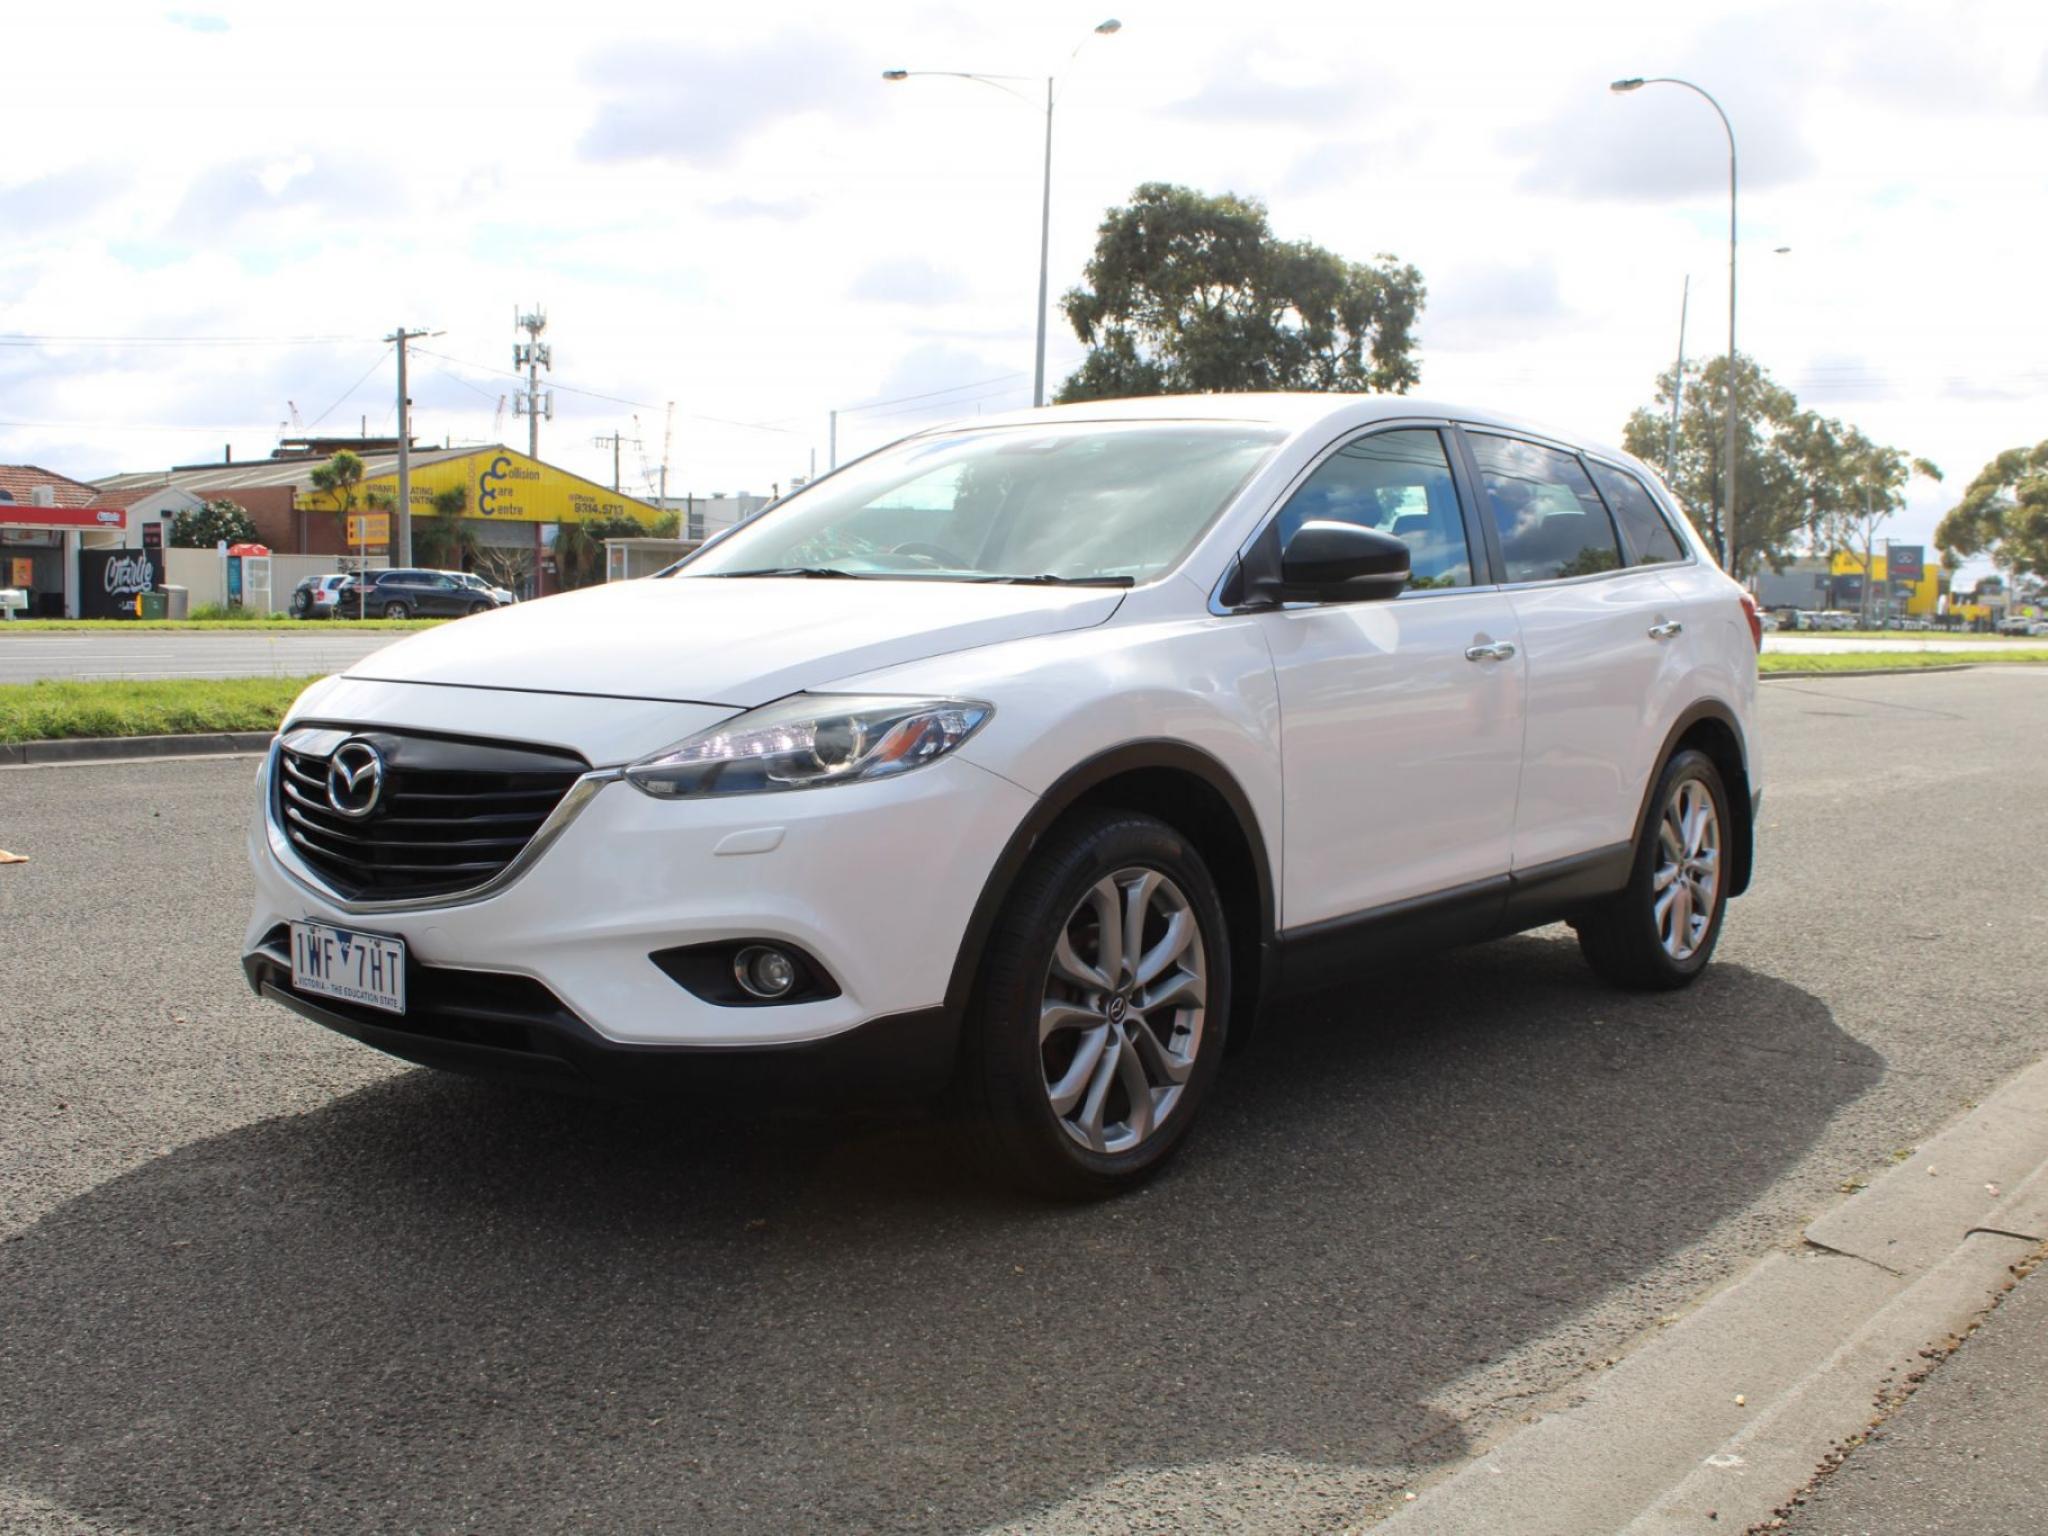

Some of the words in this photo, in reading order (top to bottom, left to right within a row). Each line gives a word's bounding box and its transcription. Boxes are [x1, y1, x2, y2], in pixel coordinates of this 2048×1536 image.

[491, 456, 540, 480] Collision
[480, 471, 514, 497] Care
[478, 493, 524, 516] Centre
[297, 932, 334, 980] 1WF
[354, 944, 398, 995] 7HT
[298, 977, 325, 991] VICTORIA
[331, 984, 343, 995] THE
[344, 986, 378, 1003] EDUCATION
[380, 994, 398, 1008] STATE
